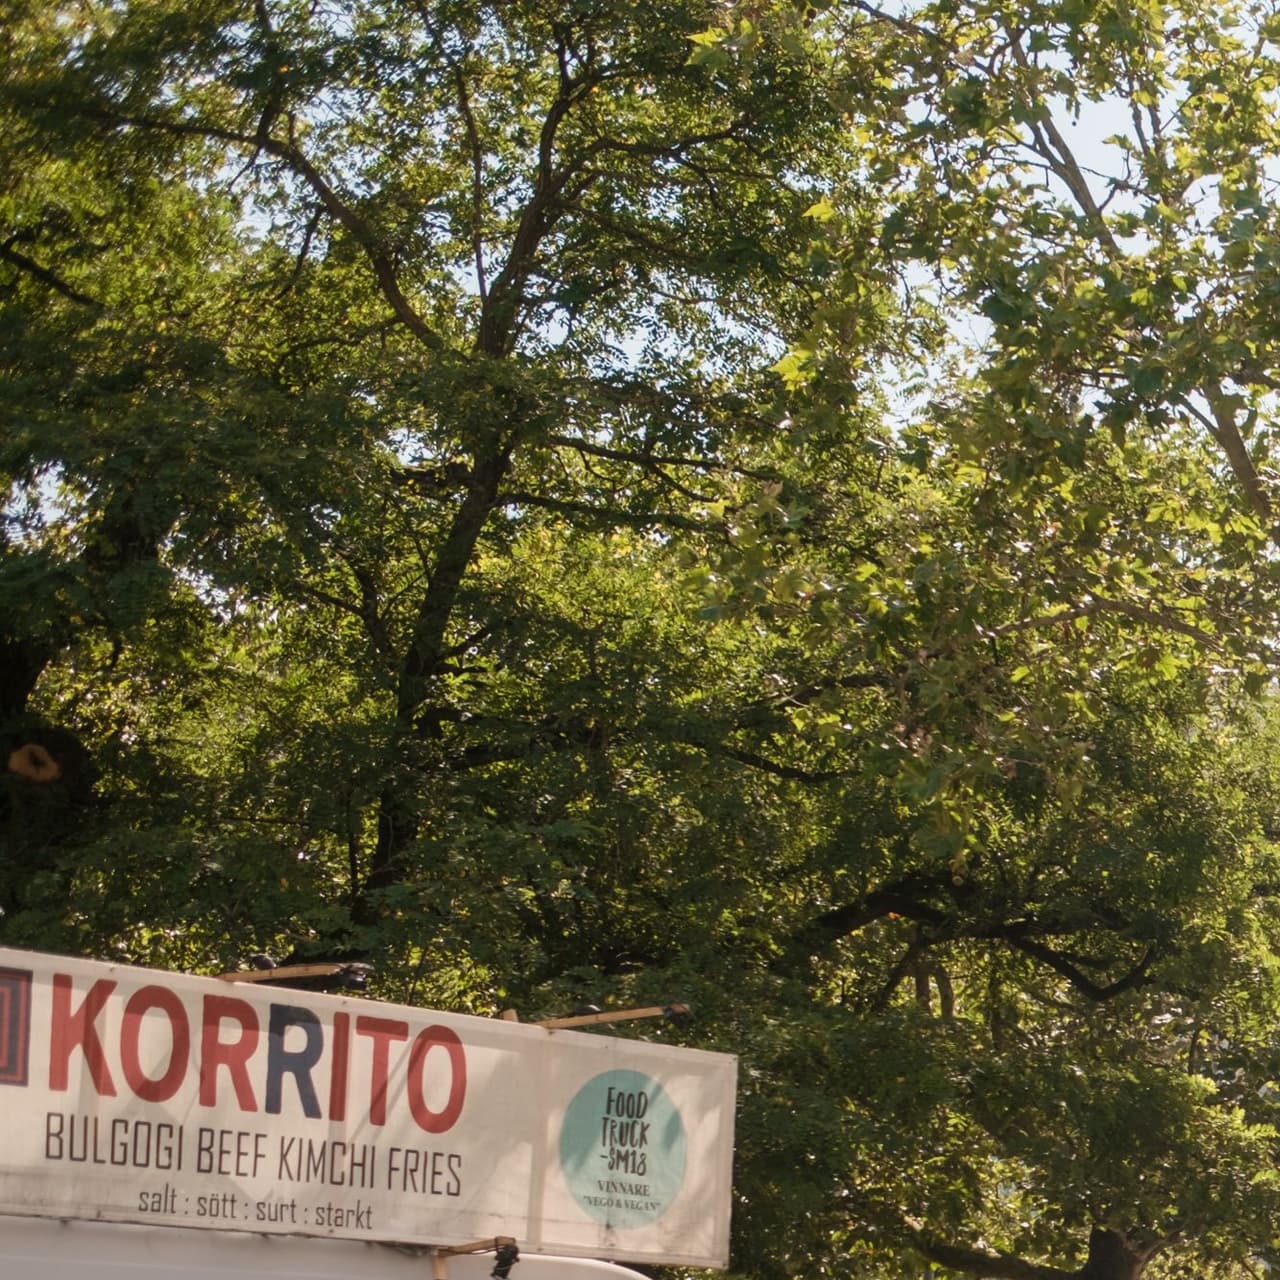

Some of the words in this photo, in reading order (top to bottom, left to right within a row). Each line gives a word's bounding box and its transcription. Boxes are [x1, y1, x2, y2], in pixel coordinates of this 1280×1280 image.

[48, 972, 467, 1134] KORRITO
[605, 1086, 648, 1119] FOOD
[602, 1117, 650, 1149] TRUCK
[45, 1112, 183, 1171] BULGOGI
[197, 1128, 267, 1179] BEEF
[278, 1135, 375, 1190] KIMCHI
[388, 1147, 462, 1198] FRIES
[138, 1183, 177, 1214] salt
[197, 1191, 237, 1220] sött
[256, 1195, 297, 1225] surt
[315, 1200, 372, 1231] starkt
[597, 1179, 650, 1197] VINNARE
